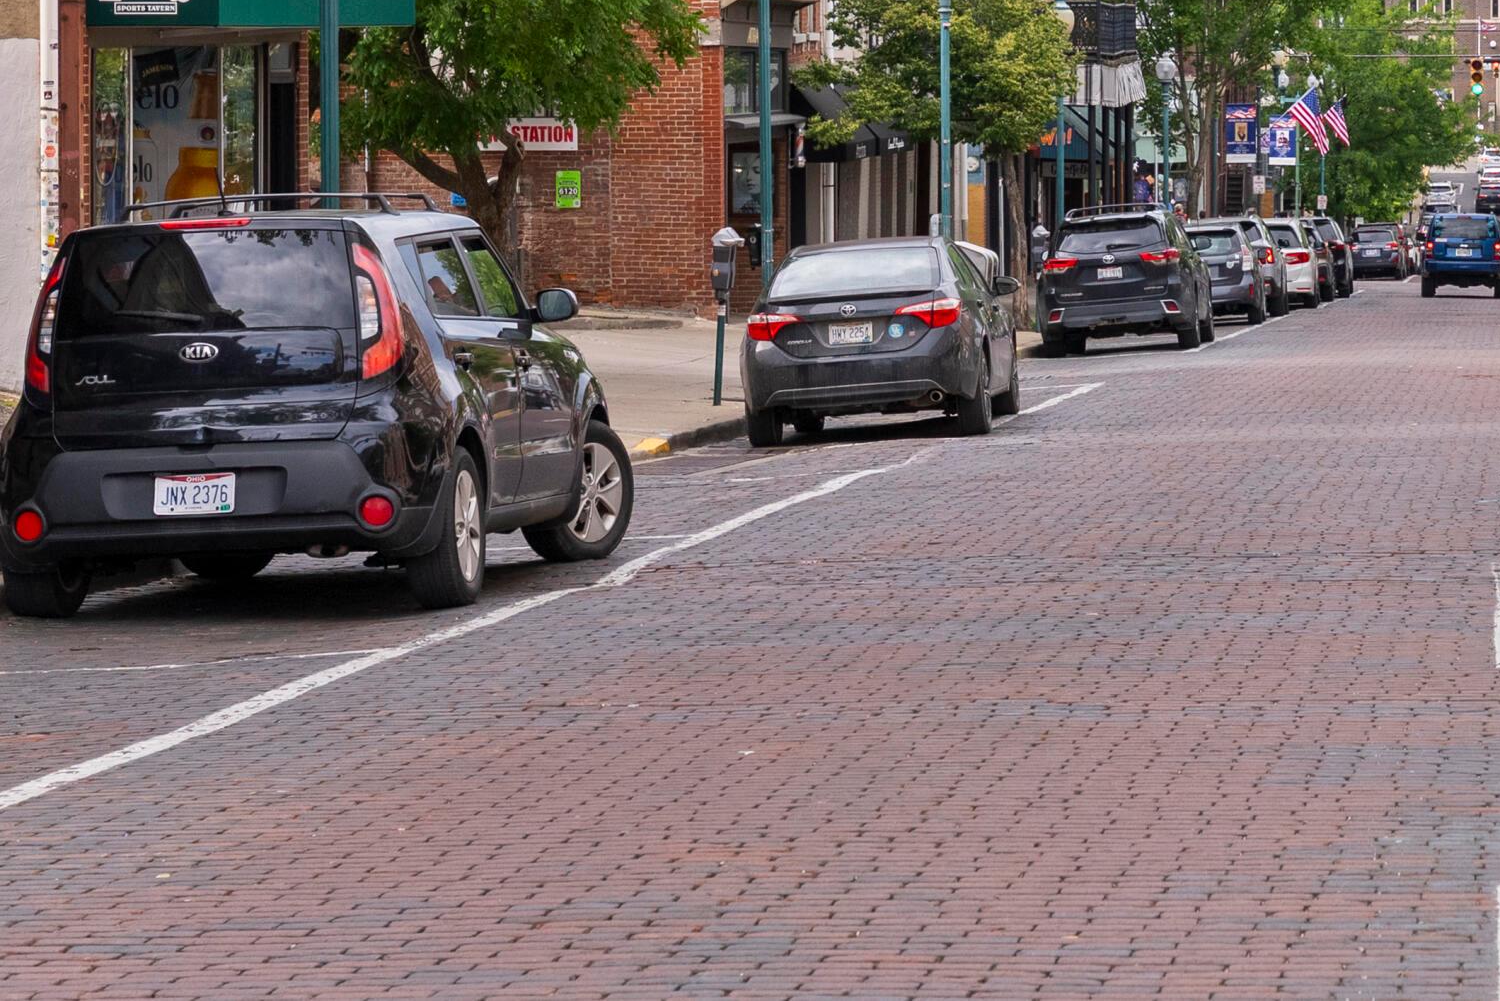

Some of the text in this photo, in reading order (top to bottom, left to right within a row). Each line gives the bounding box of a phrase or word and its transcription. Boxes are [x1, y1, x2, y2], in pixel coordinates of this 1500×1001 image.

[511, 125, 574, 143] STATION
[559, 187, 578, 195] 6120
[832, 327, 847, 338] HWY
[185, 346, 212, 359] KIA
[75, 374, 116, 386] SOUL
[185, 475, 206, 483] OHIO
[161, 484, 229, 506] JNX 2376
